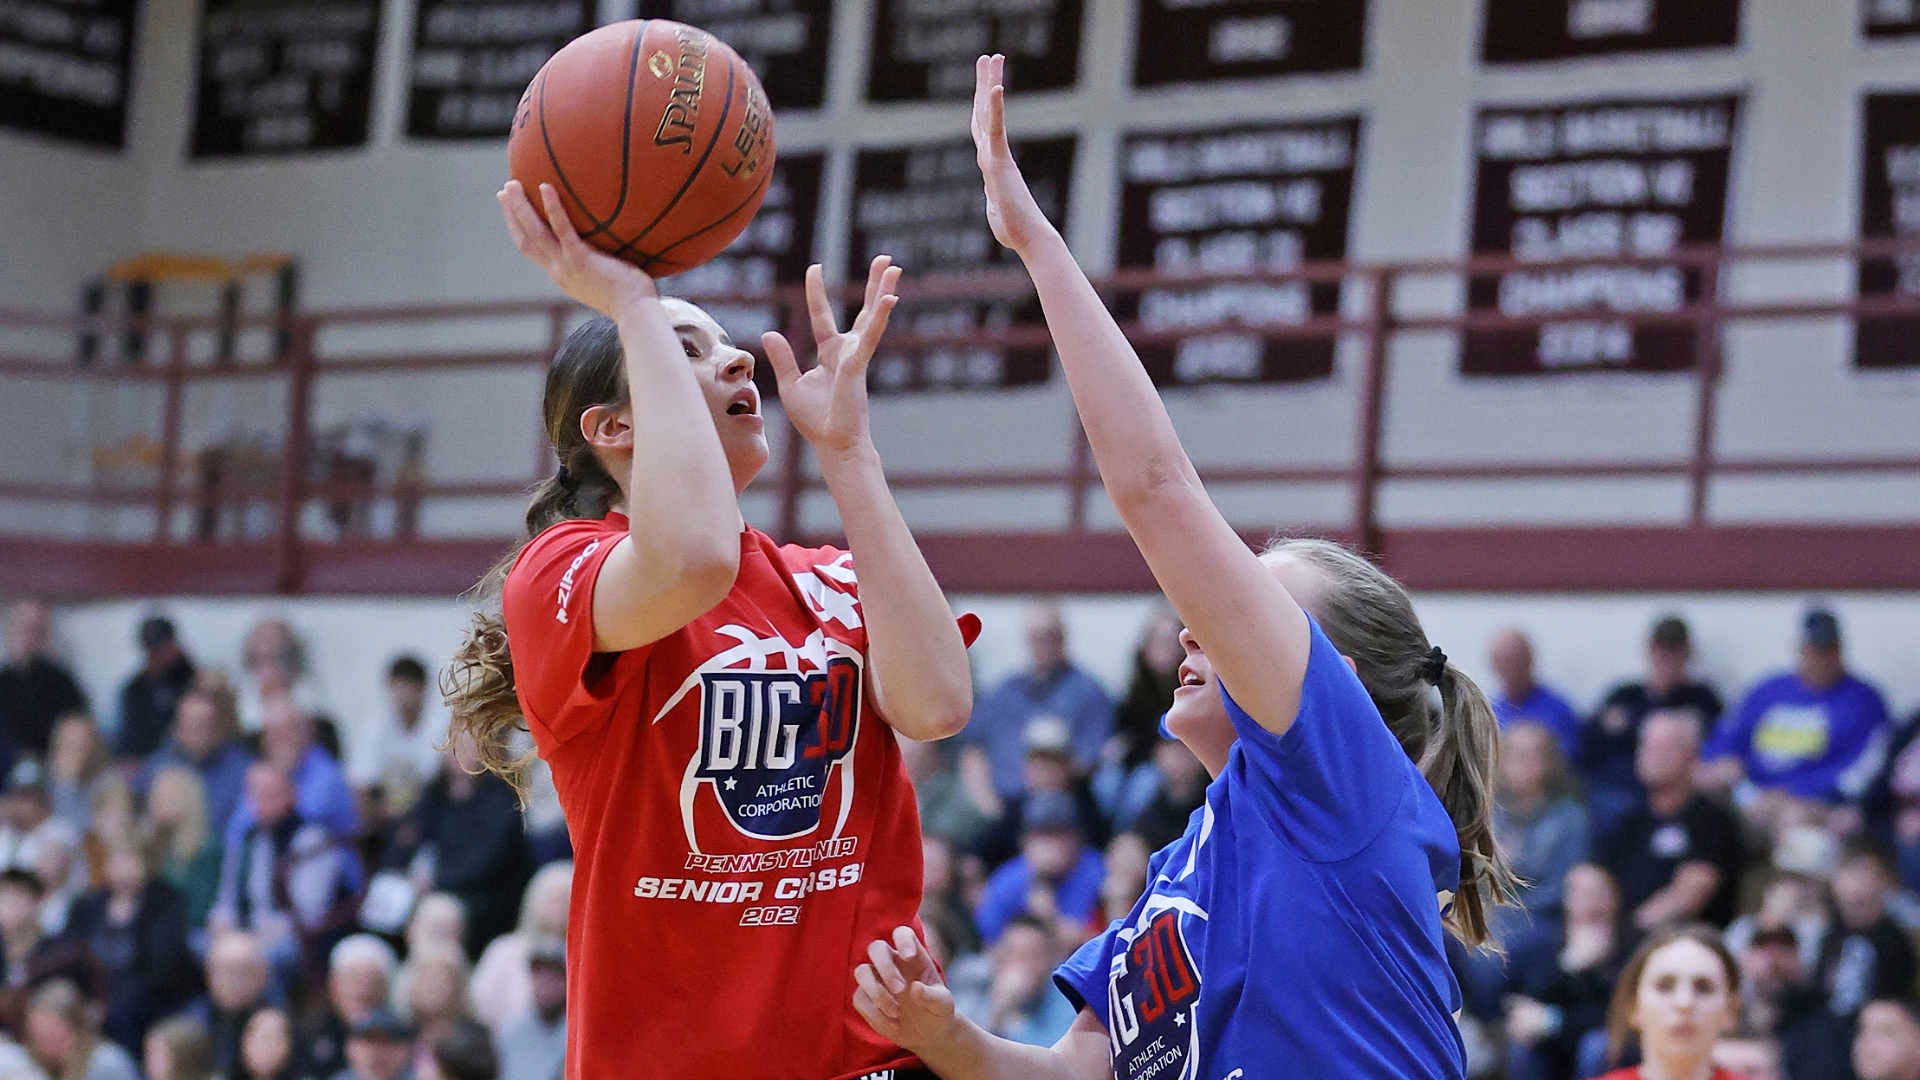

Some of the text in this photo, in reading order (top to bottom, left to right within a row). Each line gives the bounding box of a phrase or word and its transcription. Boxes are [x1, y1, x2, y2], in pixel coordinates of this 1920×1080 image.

[557, 541, 600, 609] ZIPPO
[755, 775, 815, 797] ATHLETIC
[738, 793, 823, 817] CORPORATIO
[684, 836, 858, 875] PENNSYLNIA
[634, 876, 763, 904] SENIOR
[739, 905, 803, 927] 202
[1128, 1035, 1166, 1076] ATHLETIC
